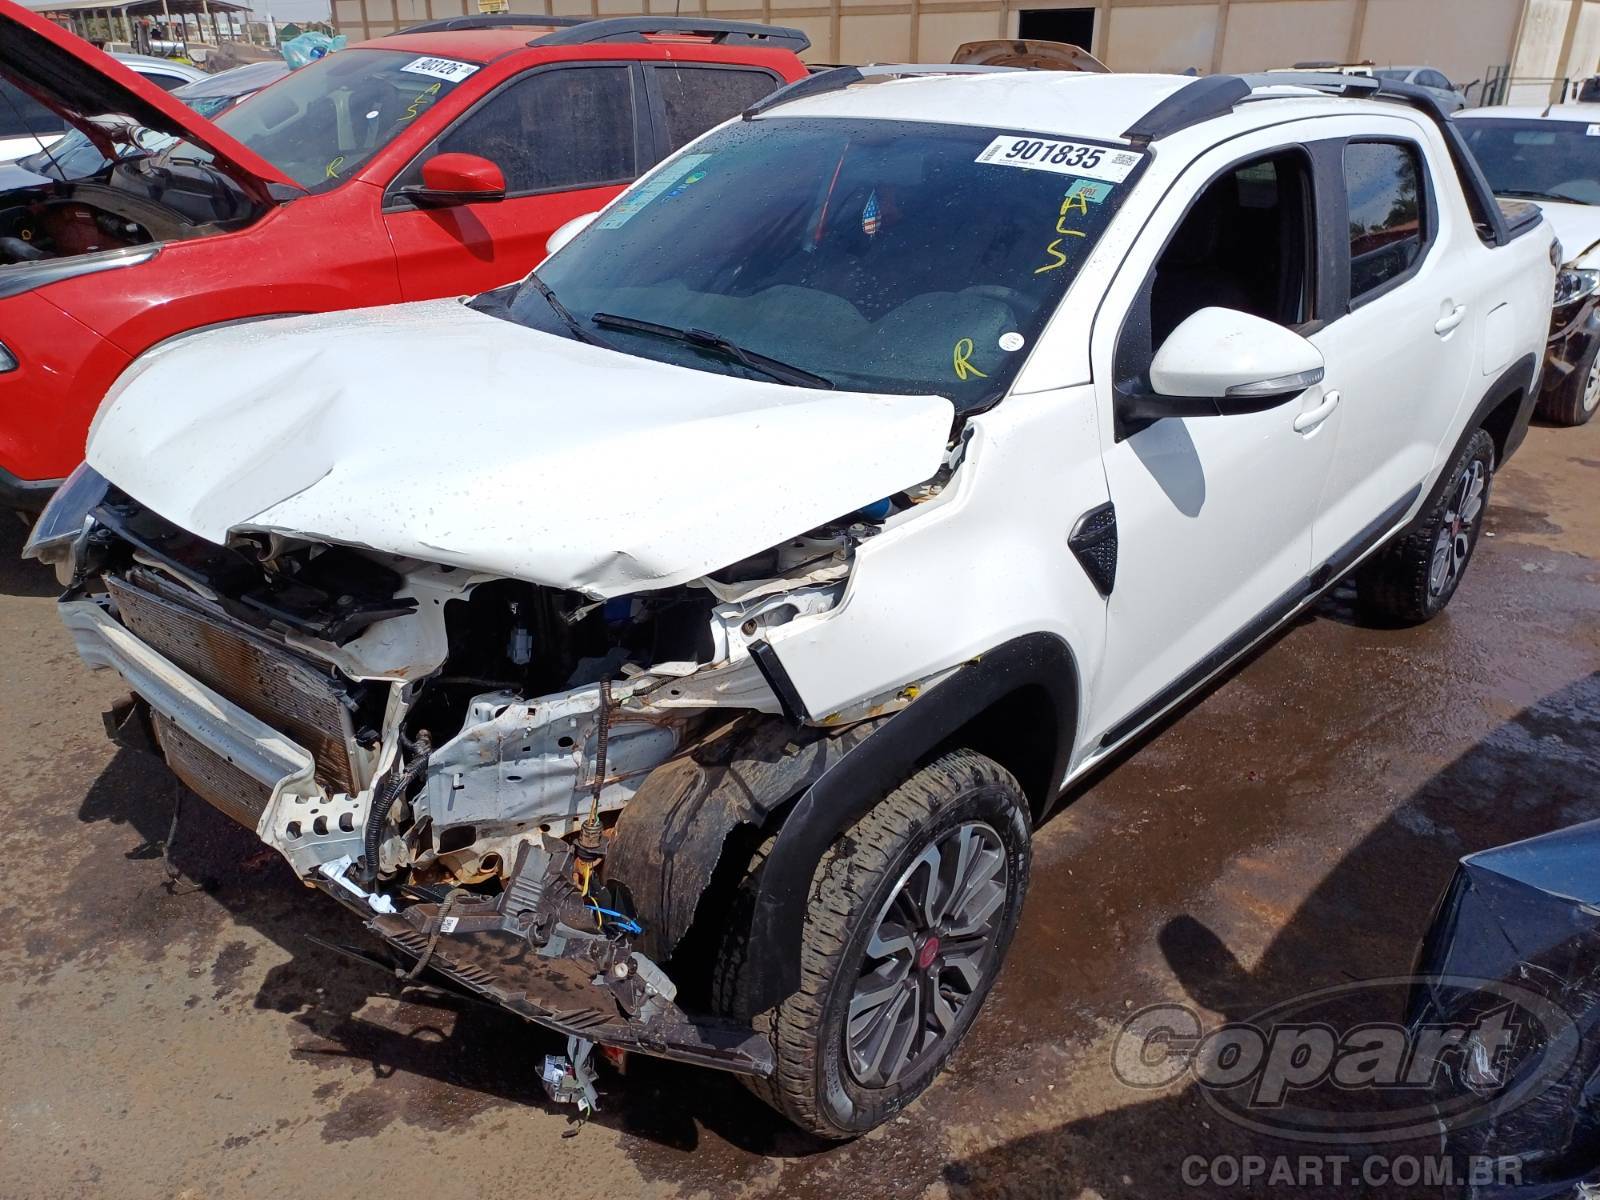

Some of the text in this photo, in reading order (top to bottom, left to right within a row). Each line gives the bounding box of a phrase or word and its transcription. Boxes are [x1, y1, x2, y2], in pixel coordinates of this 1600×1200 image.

[415, 58, 463, 75] 903126
[326, 156, 344, 178] R
[1005, 139, 1107, 169] 901835
[953, 337, 989, 380] R
